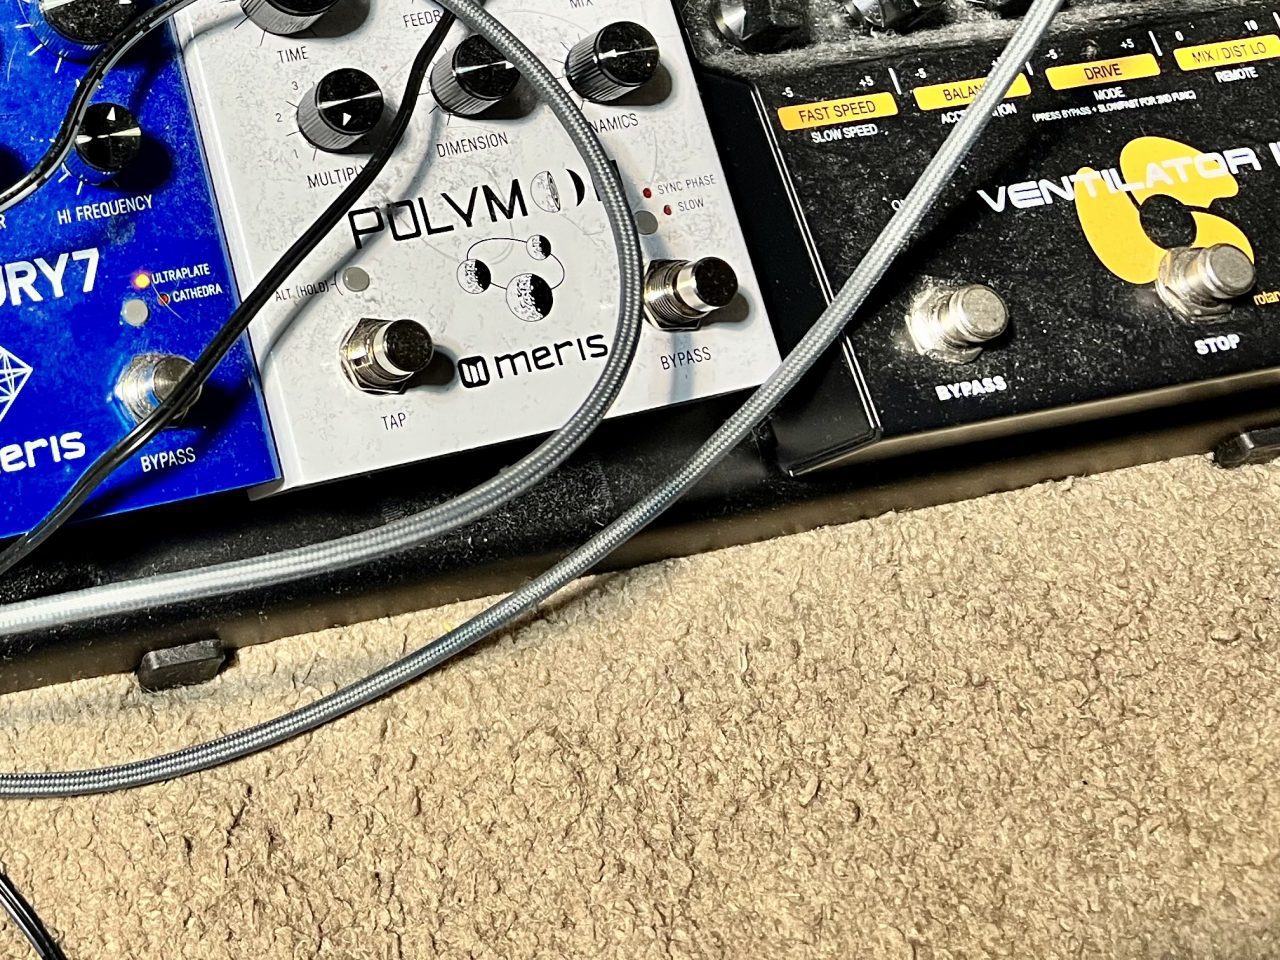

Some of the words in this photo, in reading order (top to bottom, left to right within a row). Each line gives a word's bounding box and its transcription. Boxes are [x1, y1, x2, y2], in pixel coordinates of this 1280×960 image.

[403, 9, 442, 28] FEEDB
[1243, 19, 1260, 32] 10
[1120, 38, 1135, 50] +5
[1174, 29, 1185, 42] 0
[277, 46, 309, 64] TIME
[1191, 50, 1213, 64] MIX
[1223, 44, 1249, 59] DIST
[1252, 41, 1268, 55] LO
[858, 75, 875, 87] +5
[1084, 63, 1122, 80] DRIVE
[1214, 66, 1260, 83] REMOTE
[291, 80, 299, 91] 3
[1093, 86, 1126, 101] MODE
[275, 112, 283, 123] 2
[798, 106, 831, 123] FAST
[832, 100, 877, 119] SPEED
[588, 112, 639, 136] NAMICS
[810, 128, 844, 144] SLOW
[843, 123, 879, 139] SPEED
[436, 132, 509, 158] DIMENSION
[657, 180, 683, 197] SYNC
[685, 173, 717, 192] PHASE
[977, 146, 1263, 214] VENTILATOR
[57, 209, 72, 226] HI
[75, 194, 153, 222] FREQUENCY
[677, 197, 706, 213] SLOW
[151, 263, 211, 285] ULTRAPLATE
[172, 282, 224, 303] CATHEDRA
[274, 286, 294, 303] ALT
[1194, 334, 1241, 357] STOP
[496, 333, 609, 381] meris
[660, 345, 713, 371] BYPASS
[935, 374, 1008, 402] BYPASS
[381, 412, 408, 431] TAP
[140, 447, 197, 474] BYPASS
